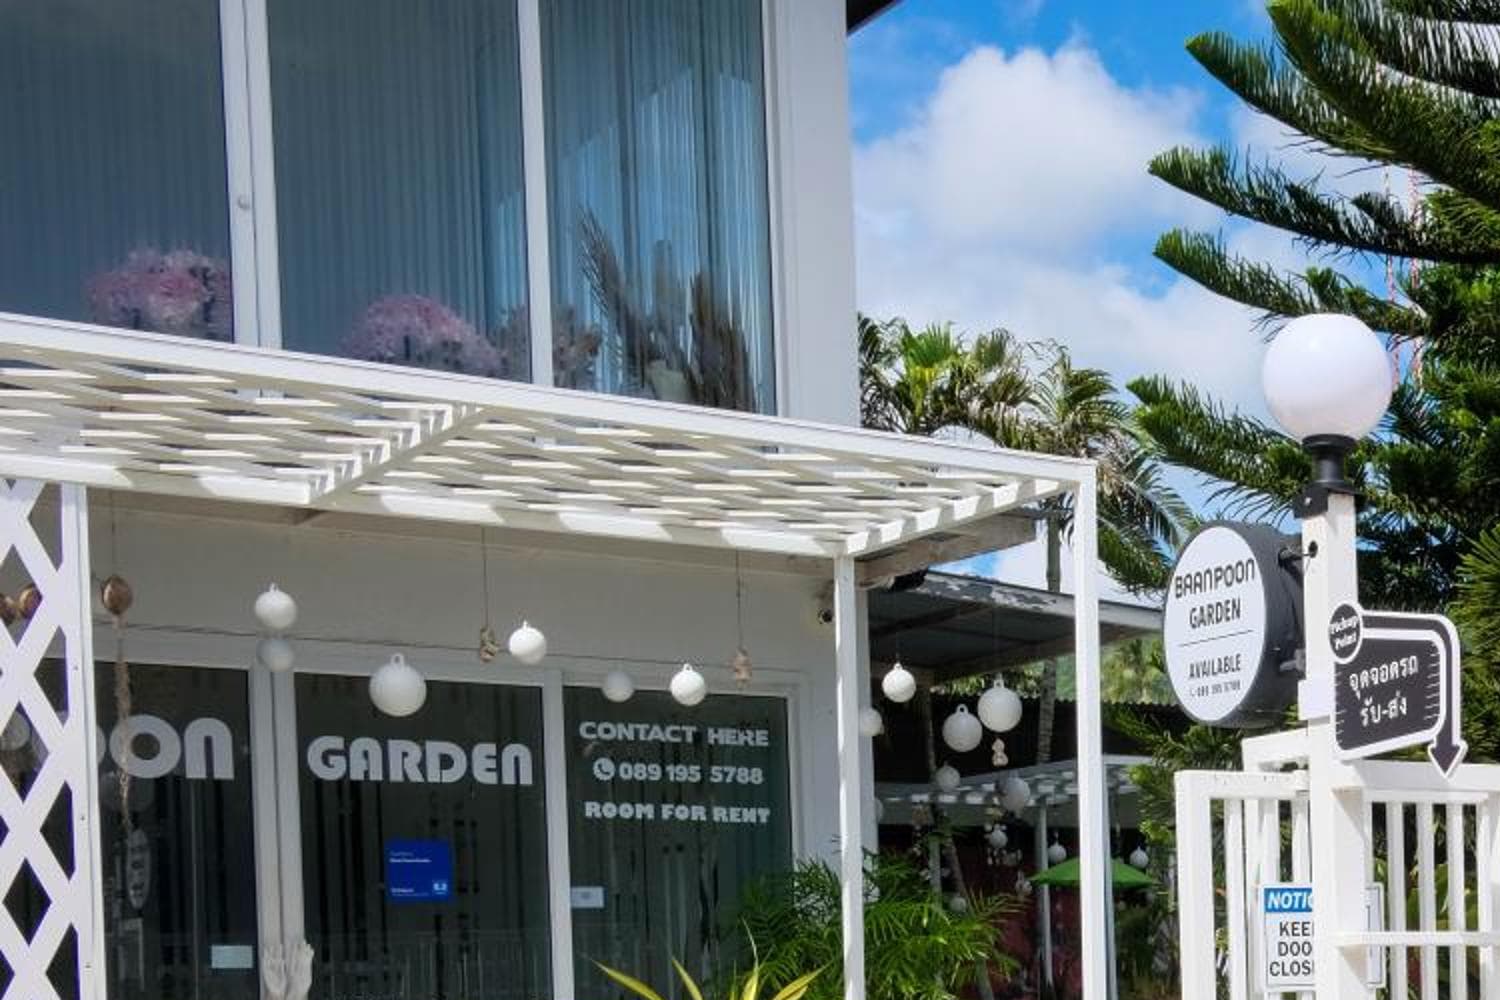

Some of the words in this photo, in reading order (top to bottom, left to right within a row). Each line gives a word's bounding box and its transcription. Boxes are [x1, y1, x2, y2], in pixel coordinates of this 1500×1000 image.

[1174, 557, 1255, 599] BAANPOON
[1189, 598, 1241, 630] GARDEN
[1188, 653, 1241, 679] AVAILABLE
[1348, 655, 1419, 700] จุดจอดรถ
[1361, 690, 1407, 727] รับ-ส่ง
[579, 721, 697, 744] CONTACT
[707, 727, 769, 747] HERE
[307, 735, 533, 787] GARDEN
[619, 762, 662, 782] 089
[665, 764, 701, 783] 195
[710, 766, 764, 785] 5788
[584, 801, 655, 820] ROOM
[661, 804, 707, 822] FOR
[713, 806, 770, 824] RENT
[1267, 891, 1313, 909] NOTI
[1279, 921, 1314, 937] KEE
[1278, 941, 1313, 957] DOO
[1269, 960, 1315, 977] CLOS
